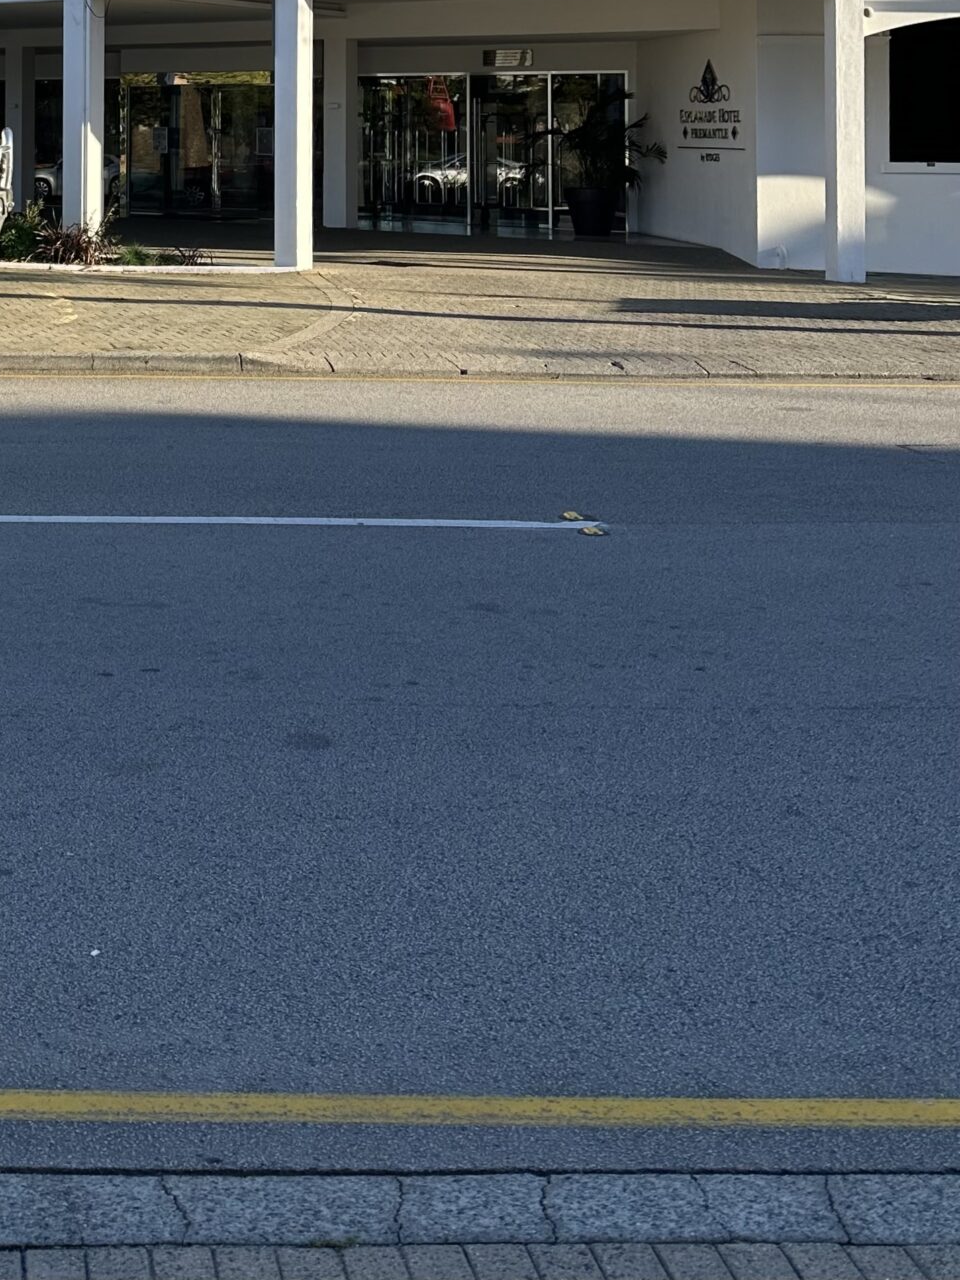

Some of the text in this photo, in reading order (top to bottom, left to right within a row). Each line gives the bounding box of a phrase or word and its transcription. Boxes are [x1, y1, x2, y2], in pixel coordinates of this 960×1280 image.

[680, 108, 741, 124] ESPLANADE HOTEL
[691, 128, 728, 139] FREMANTLE
